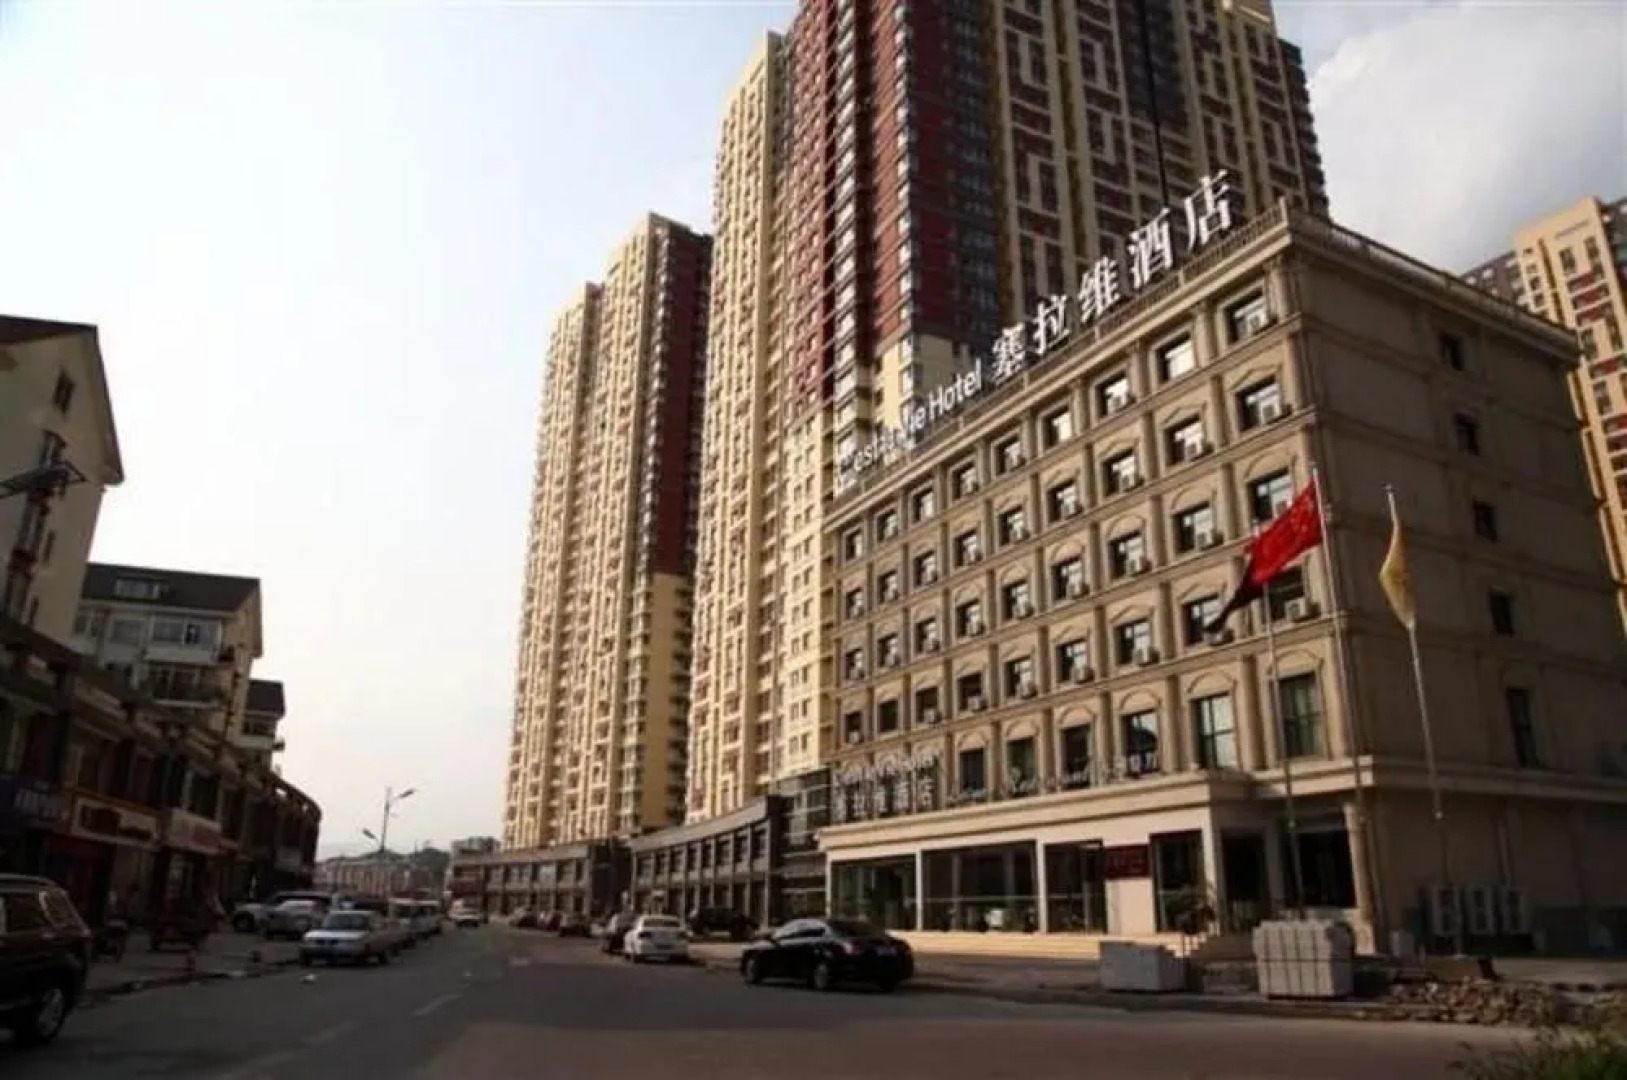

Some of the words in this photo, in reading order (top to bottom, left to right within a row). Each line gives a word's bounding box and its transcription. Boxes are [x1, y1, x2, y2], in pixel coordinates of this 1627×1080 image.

[992, 169, 1231, 386] 塞拉维酒店
[929, 358, 982, 421] Hotel
